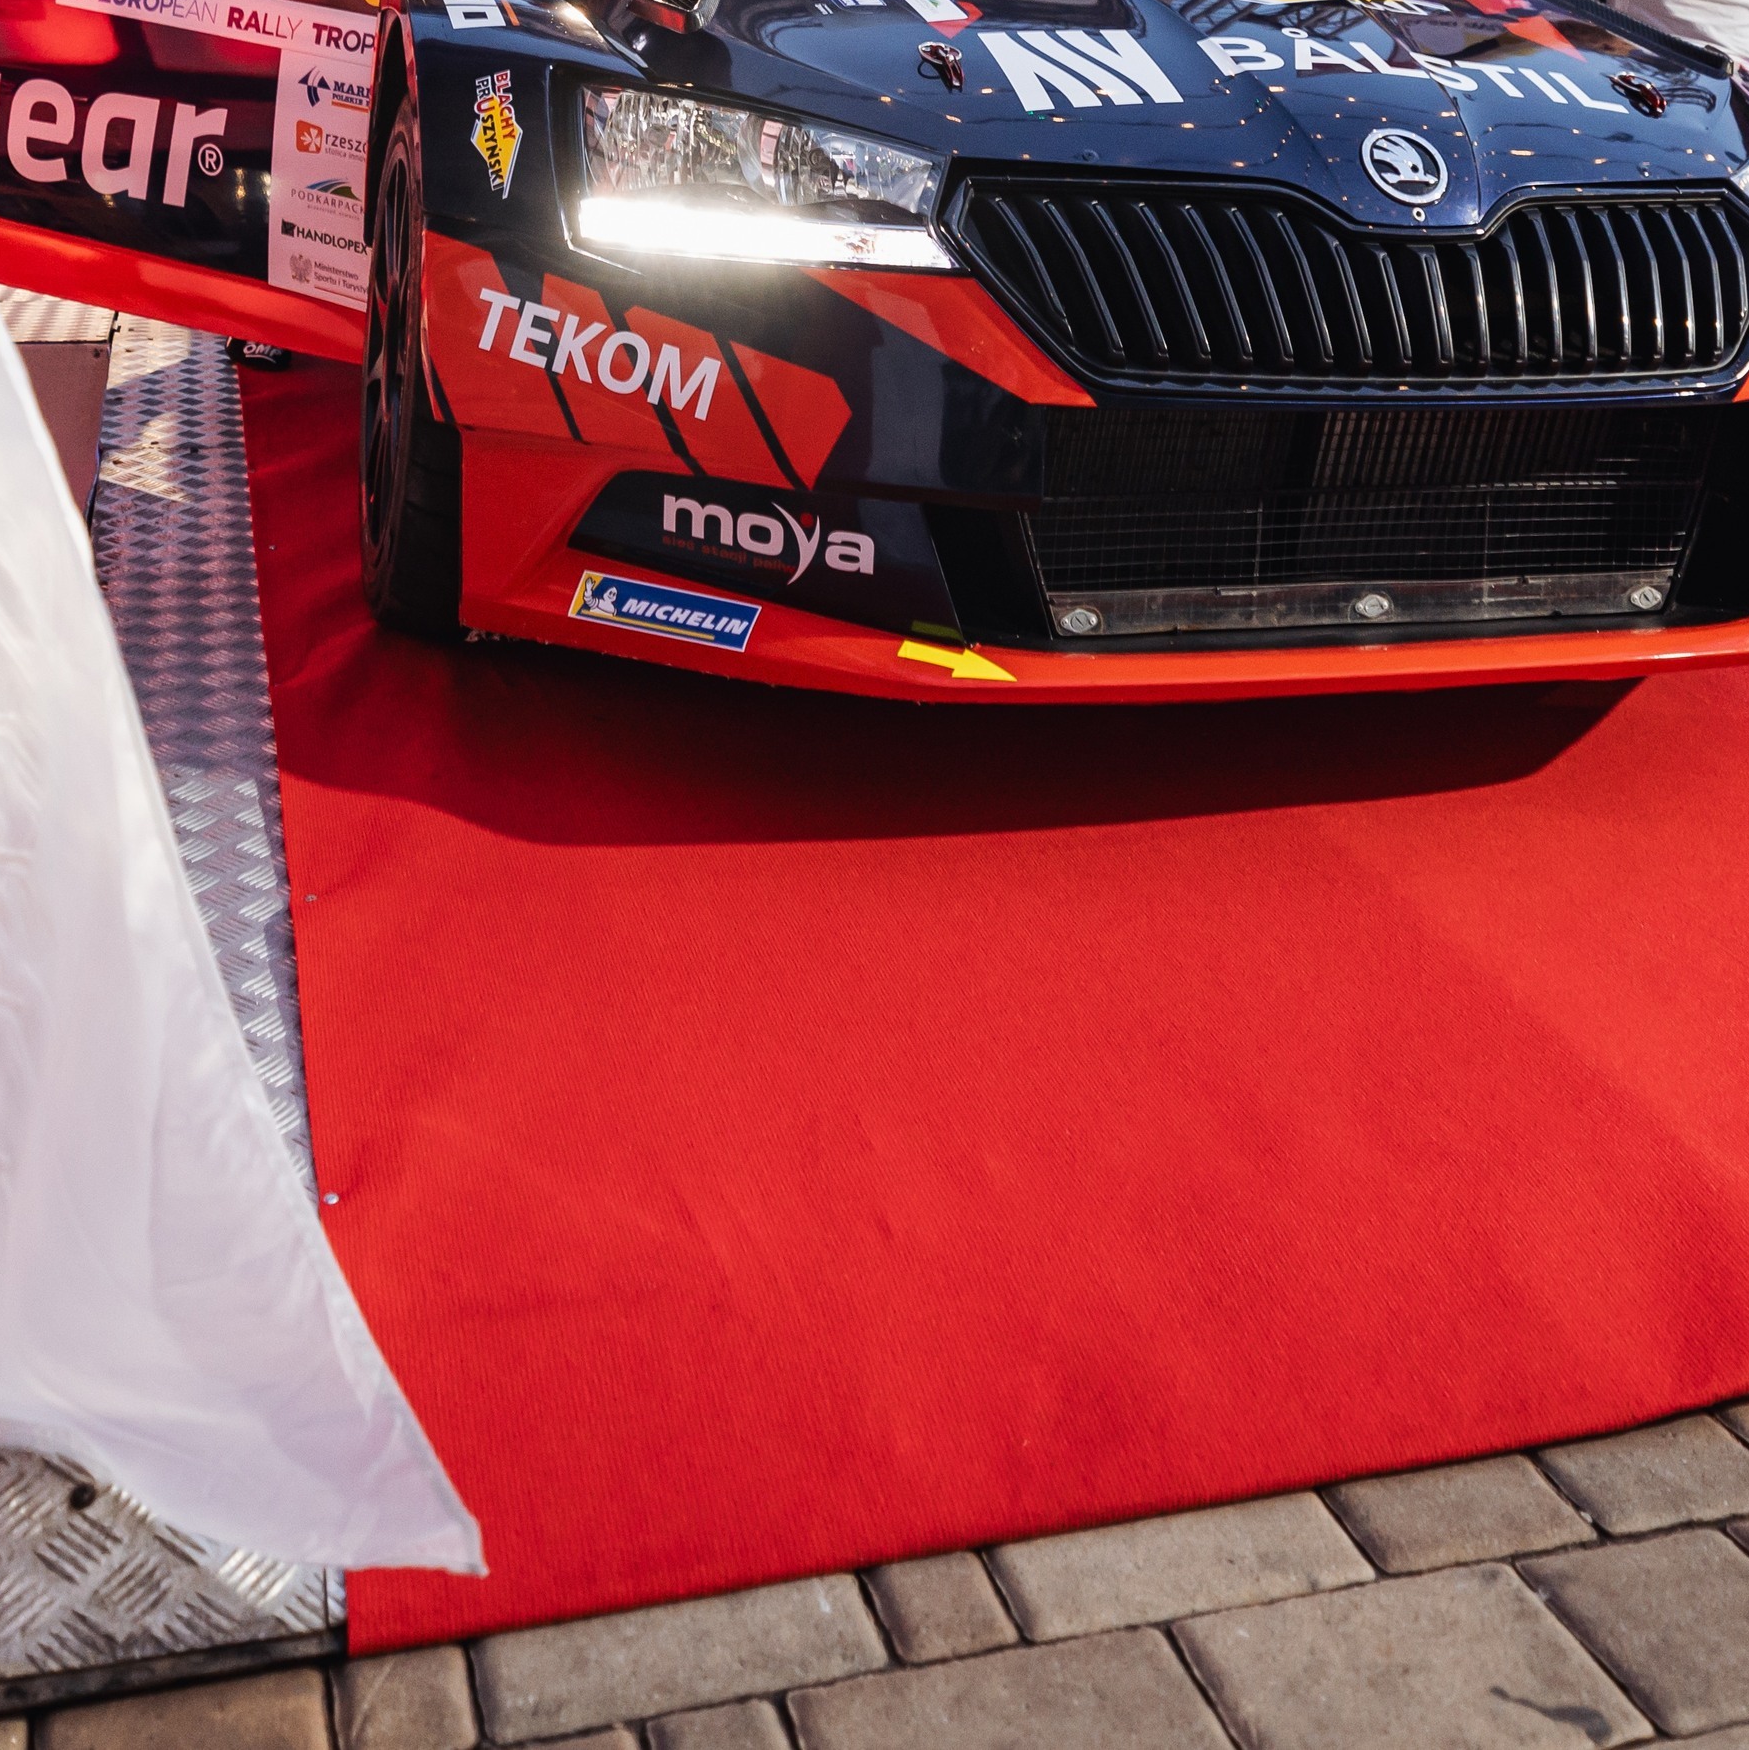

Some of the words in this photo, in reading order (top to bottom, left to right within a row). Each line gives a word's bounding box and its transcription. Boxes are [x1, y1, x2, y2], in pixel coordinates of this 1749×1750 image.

[226, 6, 304, 42] RALLY
[312, 21, 376, 54] TROP
[1197, 27, 1629, 115] BÅLSTIL
[474, 74, 505, 192] PRUSZYŃSKI
[495, 68, 516, 141] BLACHY
[296, 225, 369, 256] HANDLOPEX
[313, 260, 360, 282] Ministerstwo
[342, 276, 369, 295] Turysty
[477, 287, 722, 422] TEKOM
[662, 493, 876, 586] moya
[621, 597, 750, 637] MICHELIN
